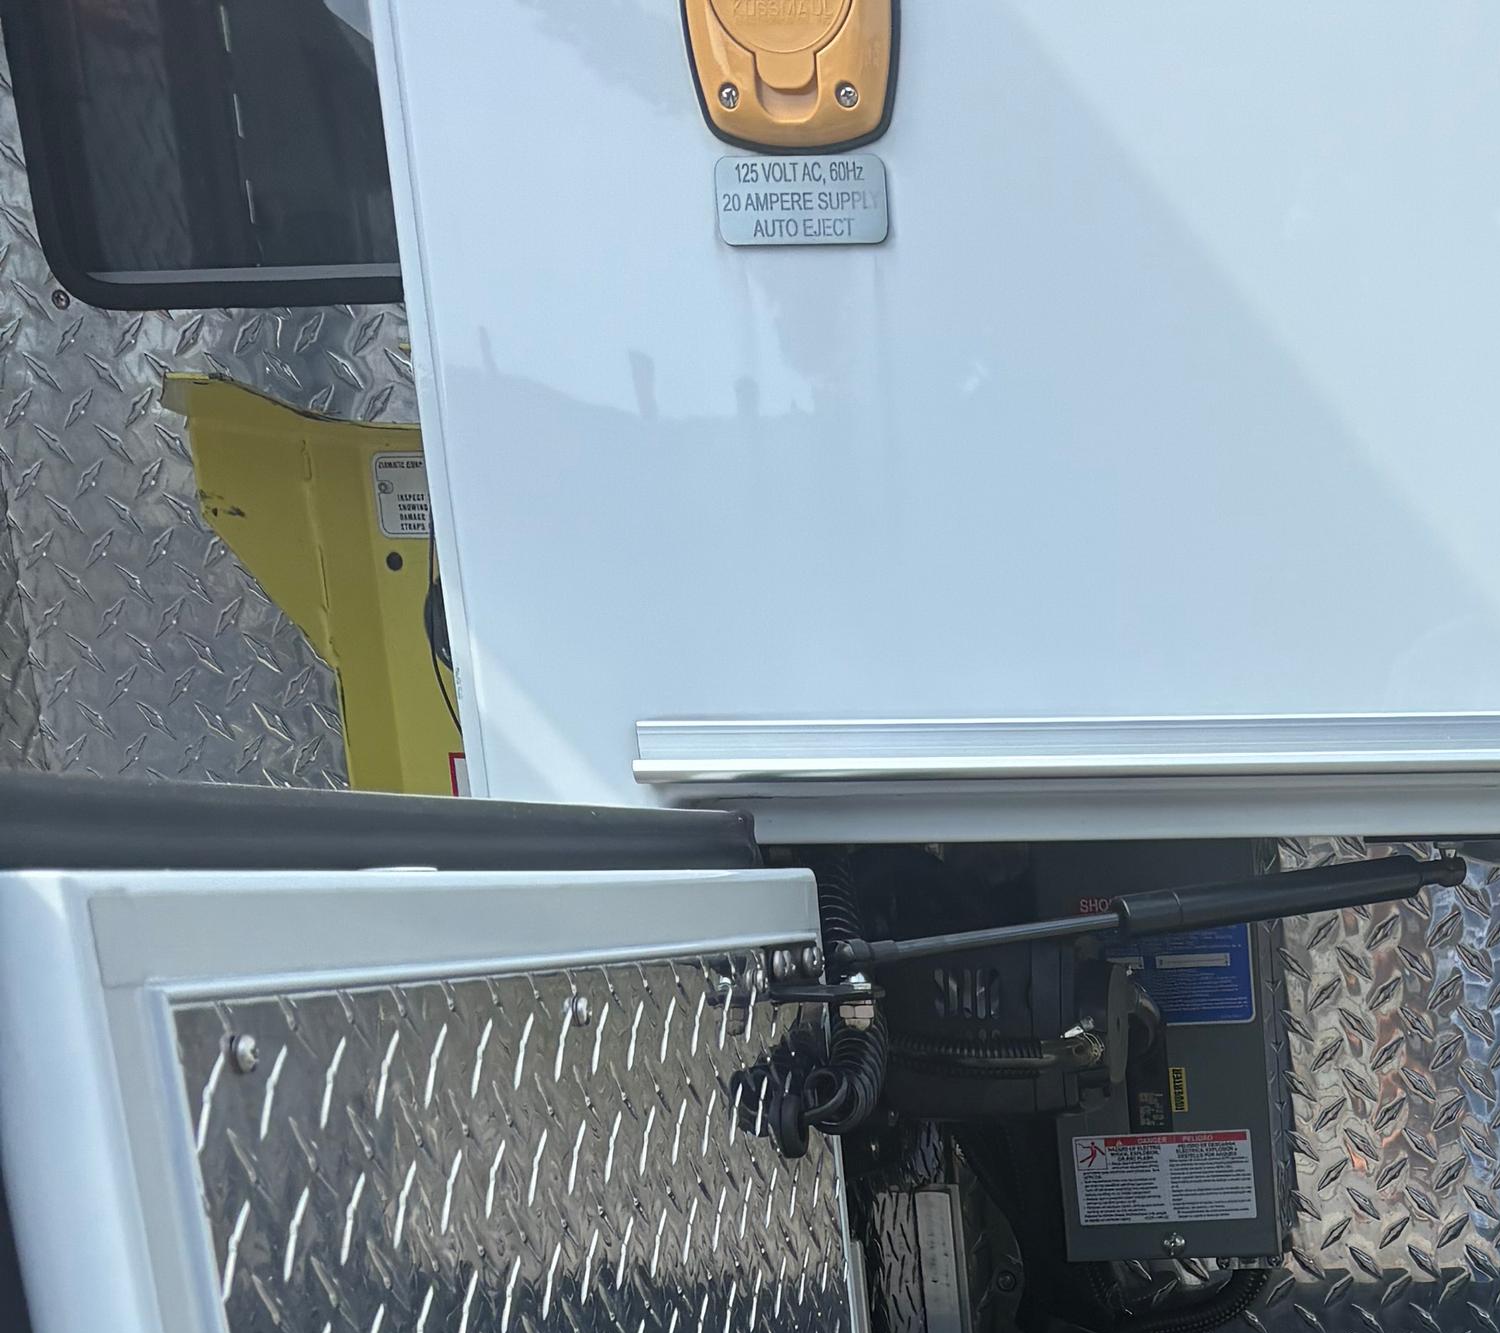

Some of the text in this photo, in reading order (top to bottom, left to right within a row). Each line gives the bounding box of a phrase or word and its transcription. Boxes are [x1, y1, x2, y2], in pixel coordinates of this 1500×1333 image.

[735, 161, 864, 185] 125 VOLT AC, 60Hz
[722, 191, 880, 212] 20 AMPERE SUPPLY
[753, 218, 855, 238] AUTO EJECT
[1080, 898, 1113, 913] SHO
[1182, 1134, 1214, 1143] PELIGRO
